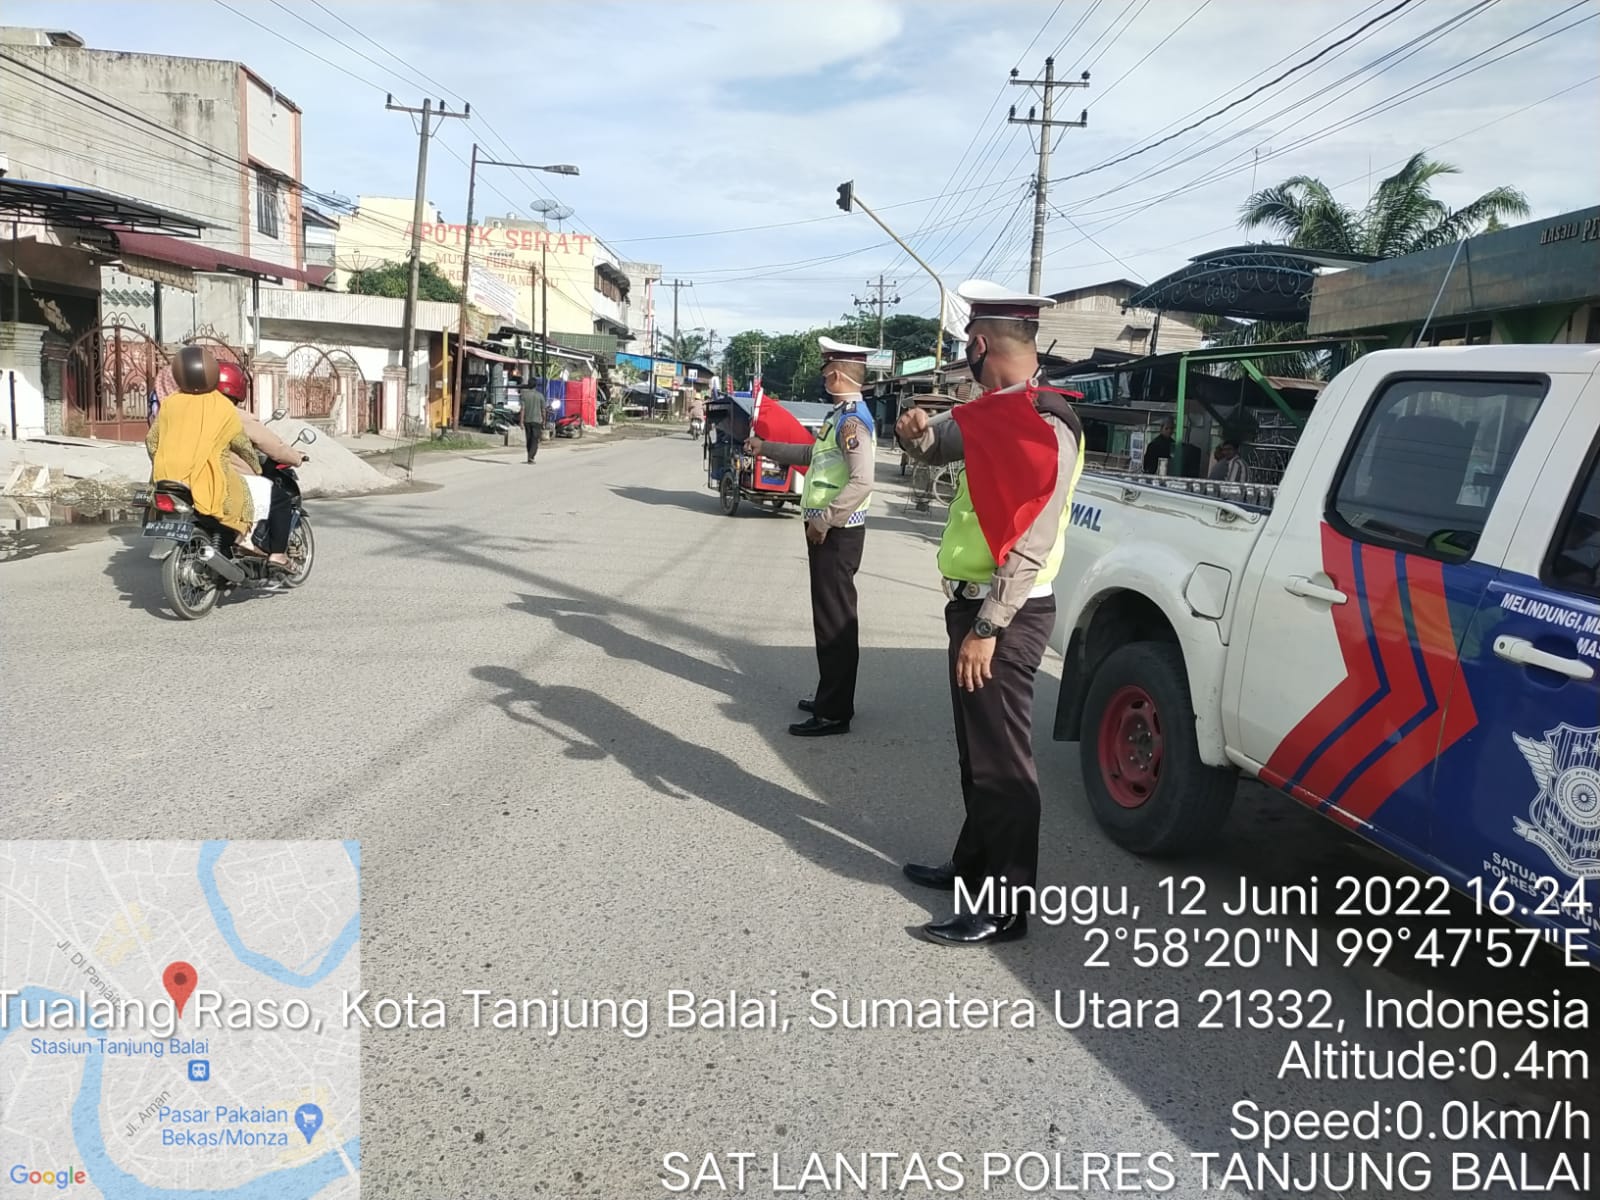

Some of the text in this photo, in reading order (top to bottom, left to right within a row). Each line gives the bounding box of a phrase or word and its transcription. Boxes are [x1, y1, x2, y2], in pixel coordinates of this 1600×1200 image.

[403, 221, 592, 256] APOTIK SEHAT
[1582, 217, 1600, 242] PE
[435, 252, 468, 265] MUT
